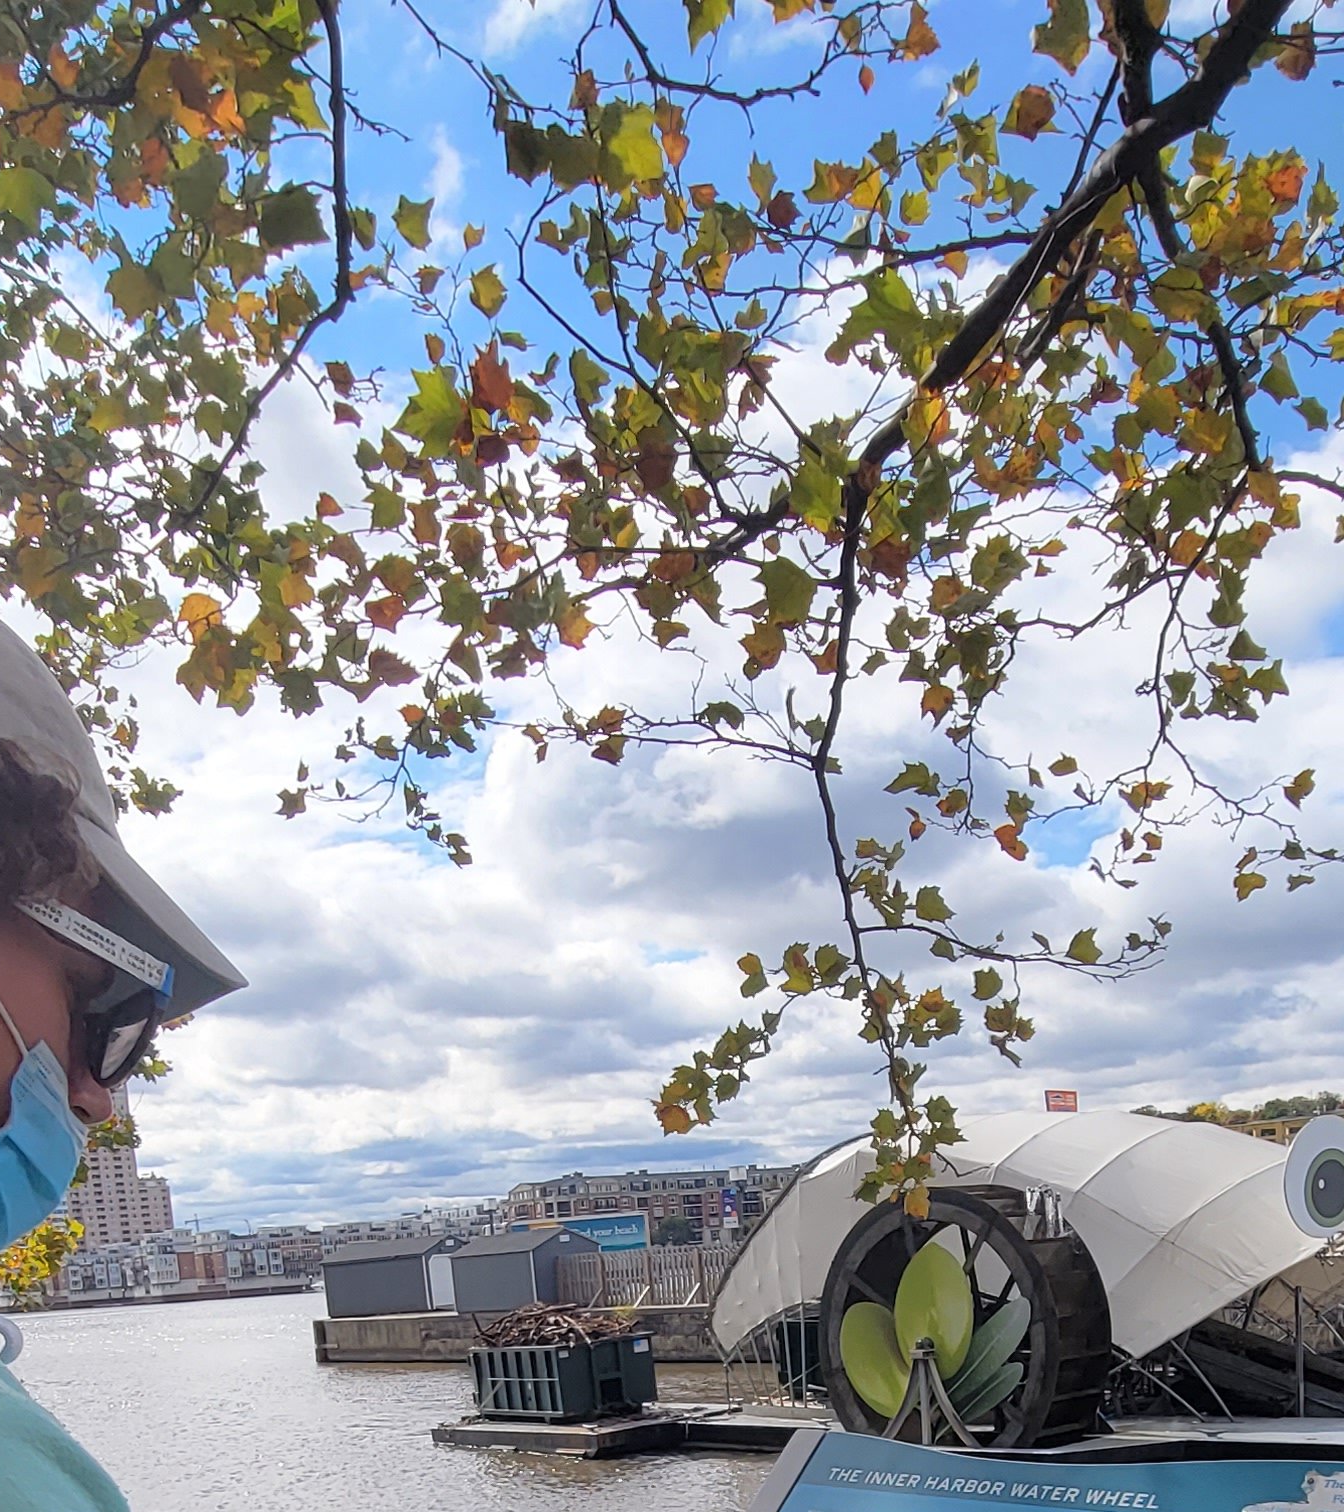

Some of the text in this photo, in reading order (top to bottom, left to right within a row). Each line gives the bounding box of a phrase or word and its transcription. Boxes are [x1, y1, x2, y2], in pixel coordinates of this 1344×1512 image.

[593, 1229, 613, 1240] your
[615, 1224, 639, 1235] beach
[828, 1468, 1160, 1509] THE INNER HARBOR WATER WHEEL
